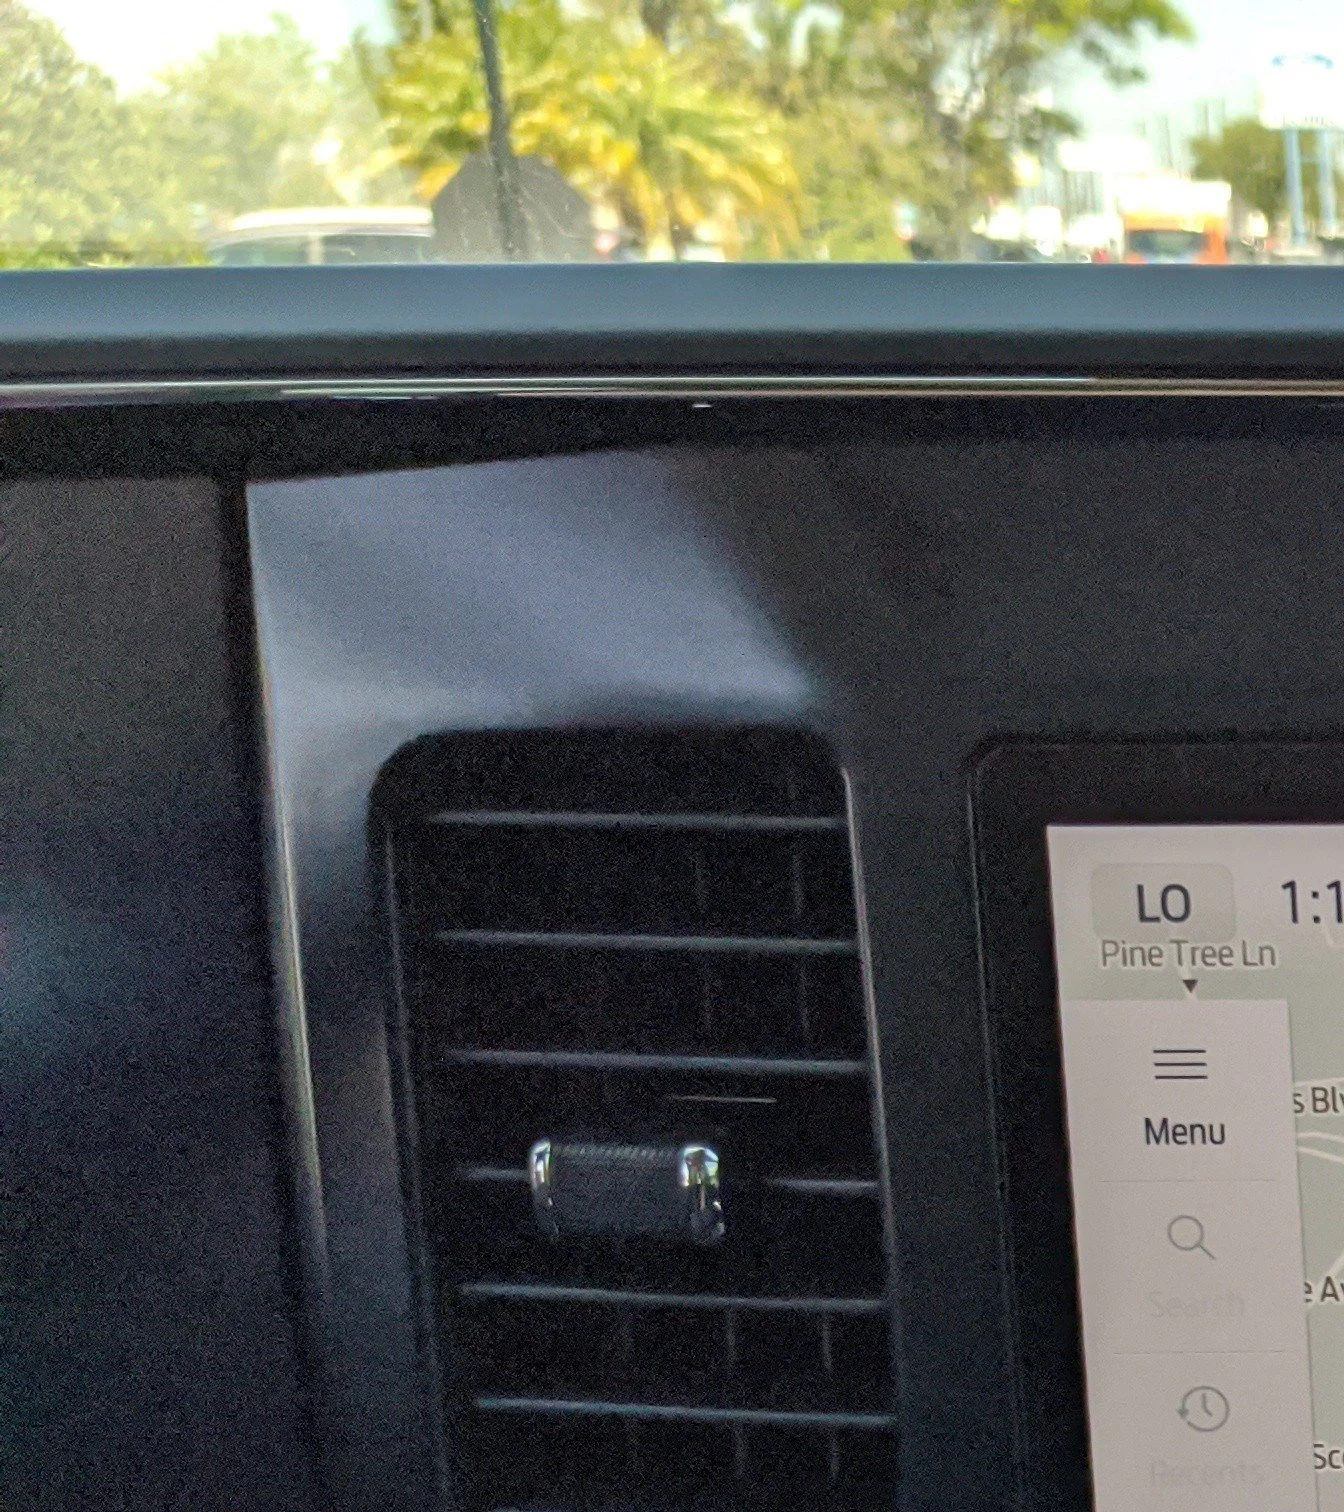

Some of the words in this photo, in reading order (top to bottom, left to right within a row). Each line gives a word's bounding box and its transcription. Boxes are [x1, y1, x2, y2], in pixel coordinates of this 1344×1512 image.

[1135, 883, 1192, 923] LO
[1100, 940, 1163, 968] Pine
[1169, 940, 1234, 968] Tree
[1240, 940, 1277, 967] Ln
[1144, 1117, 1227, 1145] Menu
